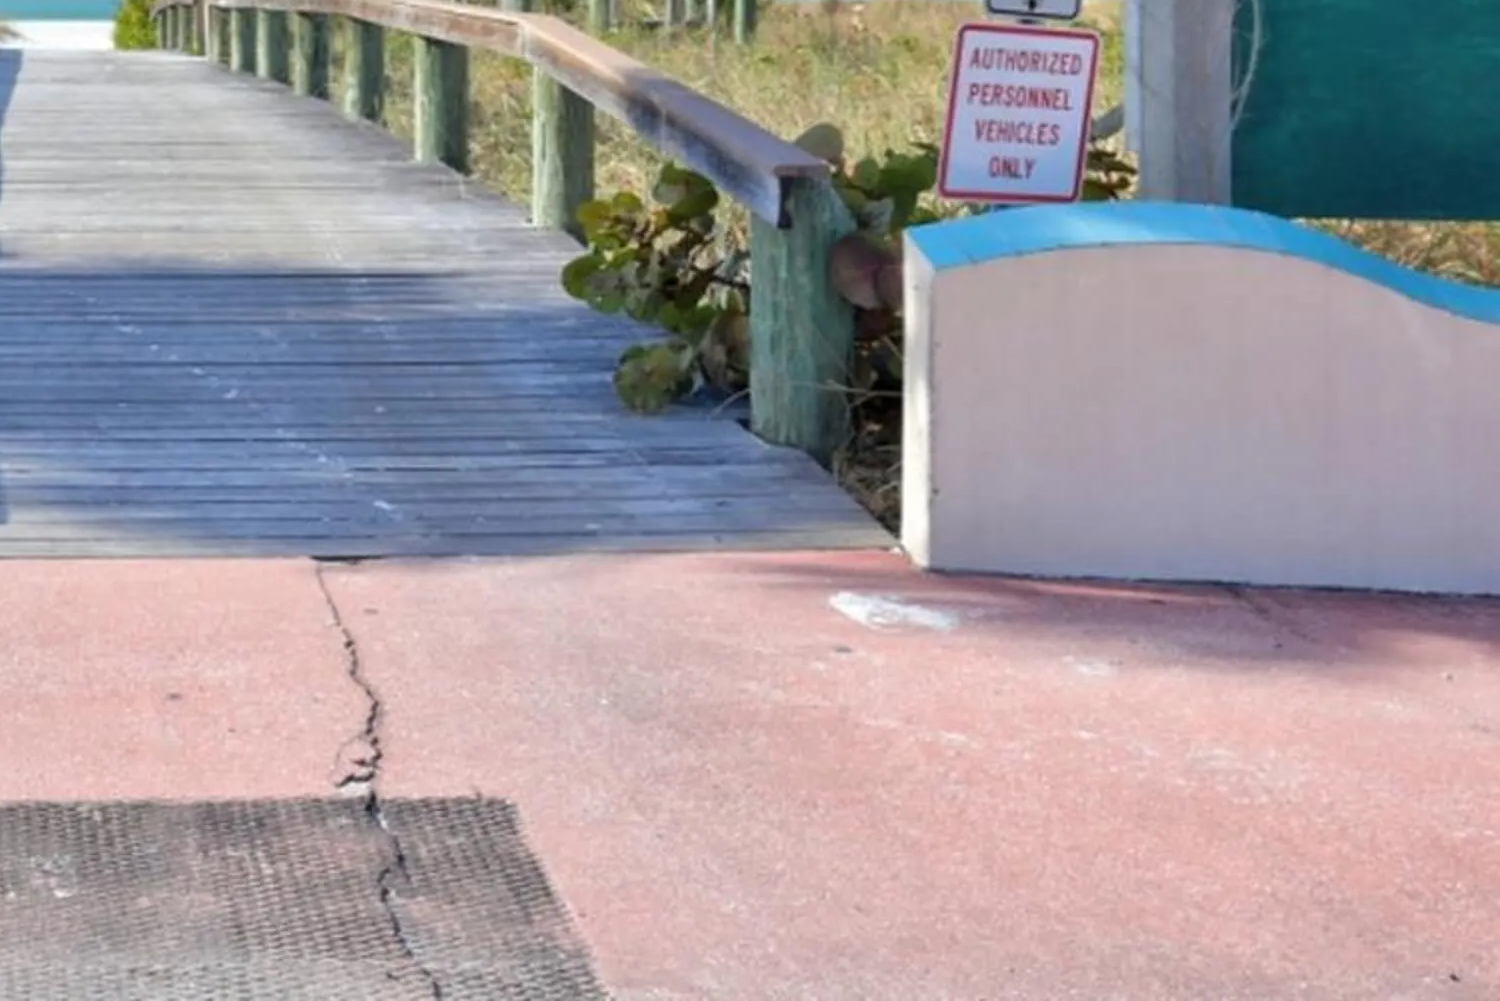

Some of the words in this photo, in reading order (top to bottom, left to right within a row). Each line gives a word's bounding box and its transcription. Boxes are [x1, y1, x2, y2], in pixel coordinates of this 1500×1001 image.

[969, 46, 1083, 76] AUTHORIZED
[966, 82, 1074, 112] PERSONNEL
[974, 118, 1061, 146] VEHICLES
[988, 155, 1037, 179] ONLY
